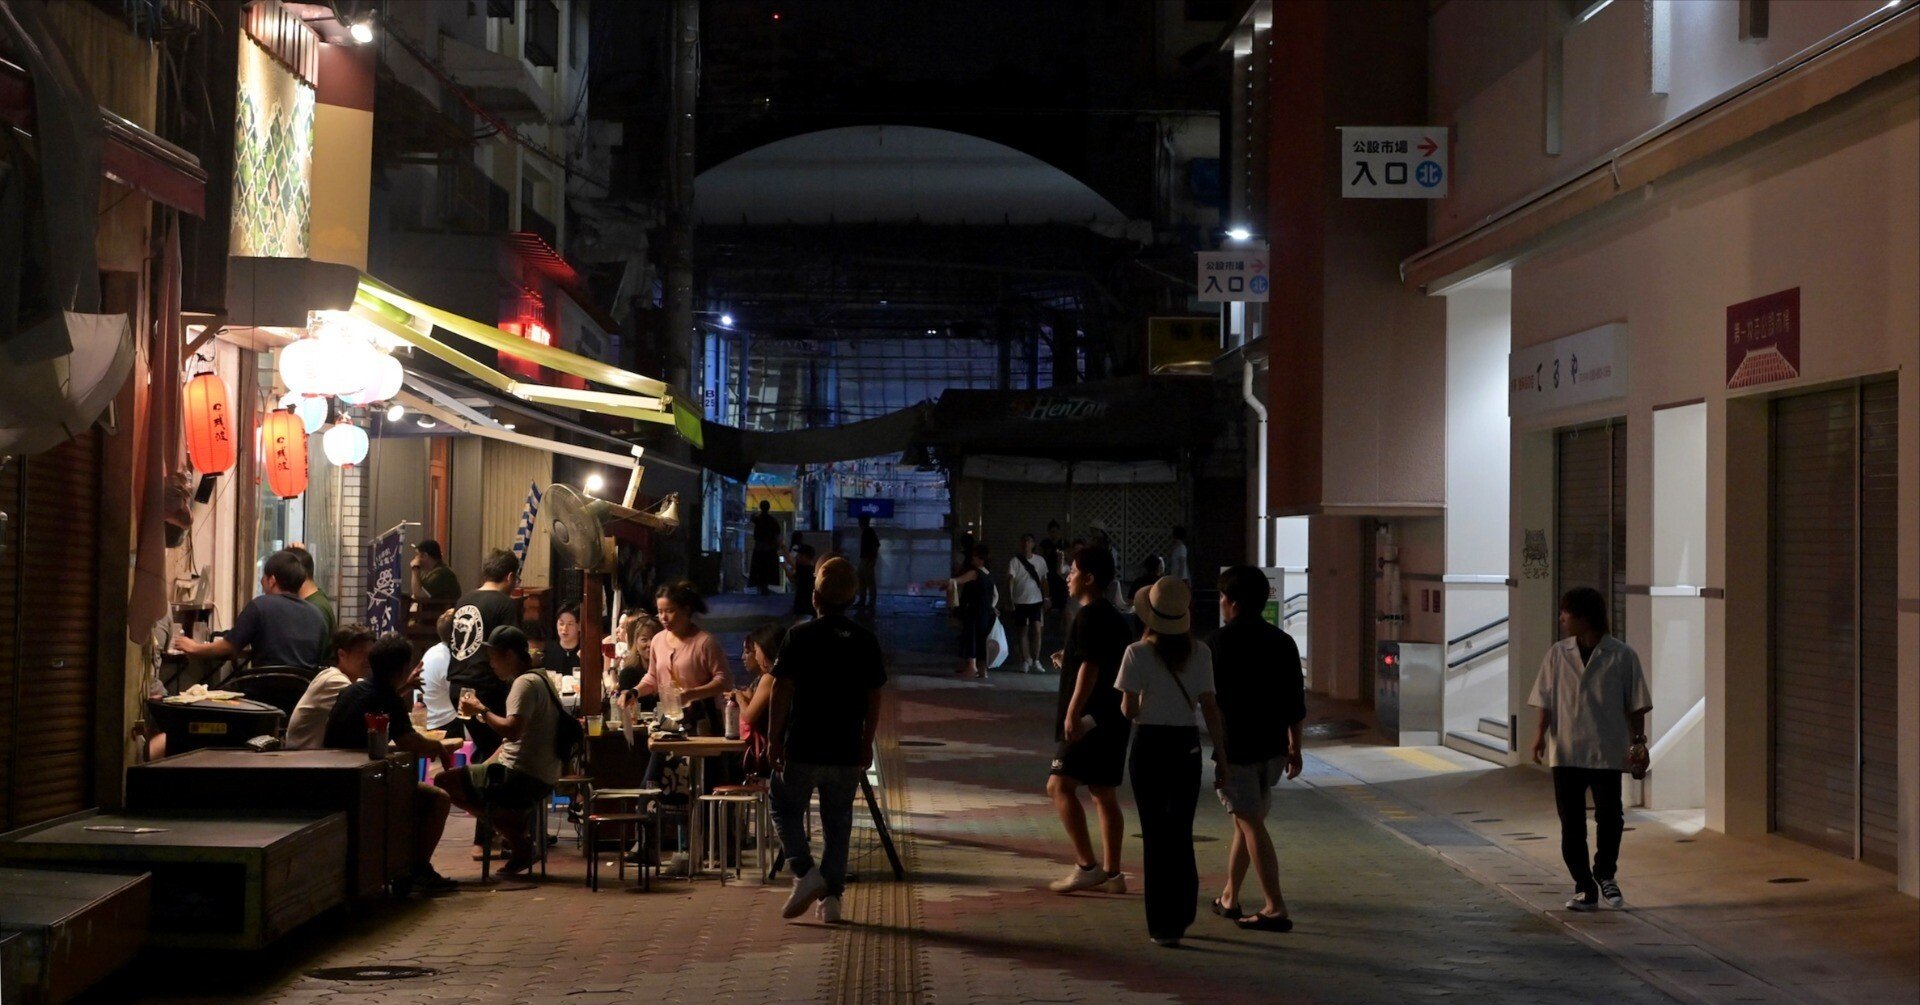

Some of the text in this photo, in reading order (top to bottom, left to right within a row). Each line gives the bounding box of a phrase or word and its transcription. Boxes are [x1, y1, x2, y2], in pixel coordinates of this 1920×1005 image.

[1352, 140, 1408, 153] 公設市場
[1351, 161, 1408, 186] 入口
[1206, 261, 1245, 271] 公設市場
[1204, 276, 1244, 293] 入口
